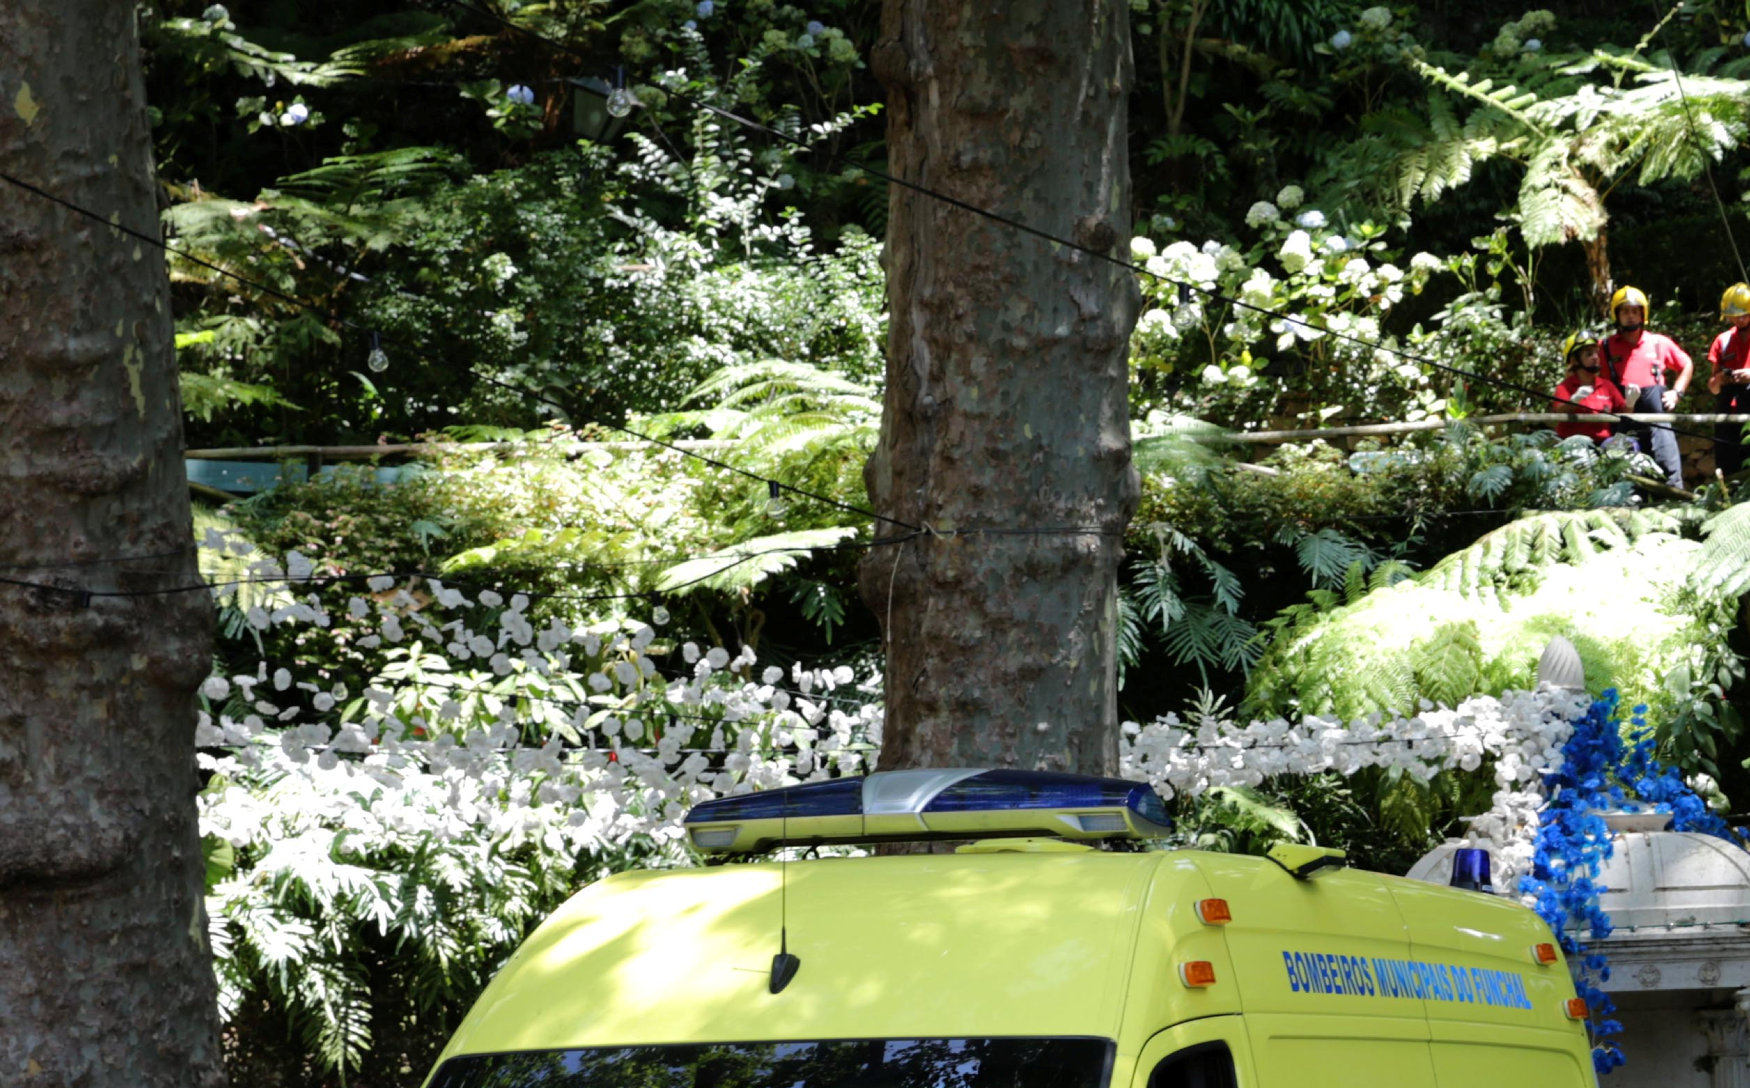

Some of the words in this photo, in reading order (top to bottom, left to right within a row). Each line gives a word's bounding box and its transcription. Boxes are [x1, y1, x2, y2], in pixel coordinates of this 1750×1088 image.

[1282, 951, 1375, 996] BOMBEIROS
[1371, 958, 1454, 1002] MUNICIPAIS
[1450, 964, 1475, 1003] DO
[1471, 967, 1533, 1009] FUNCHAL
